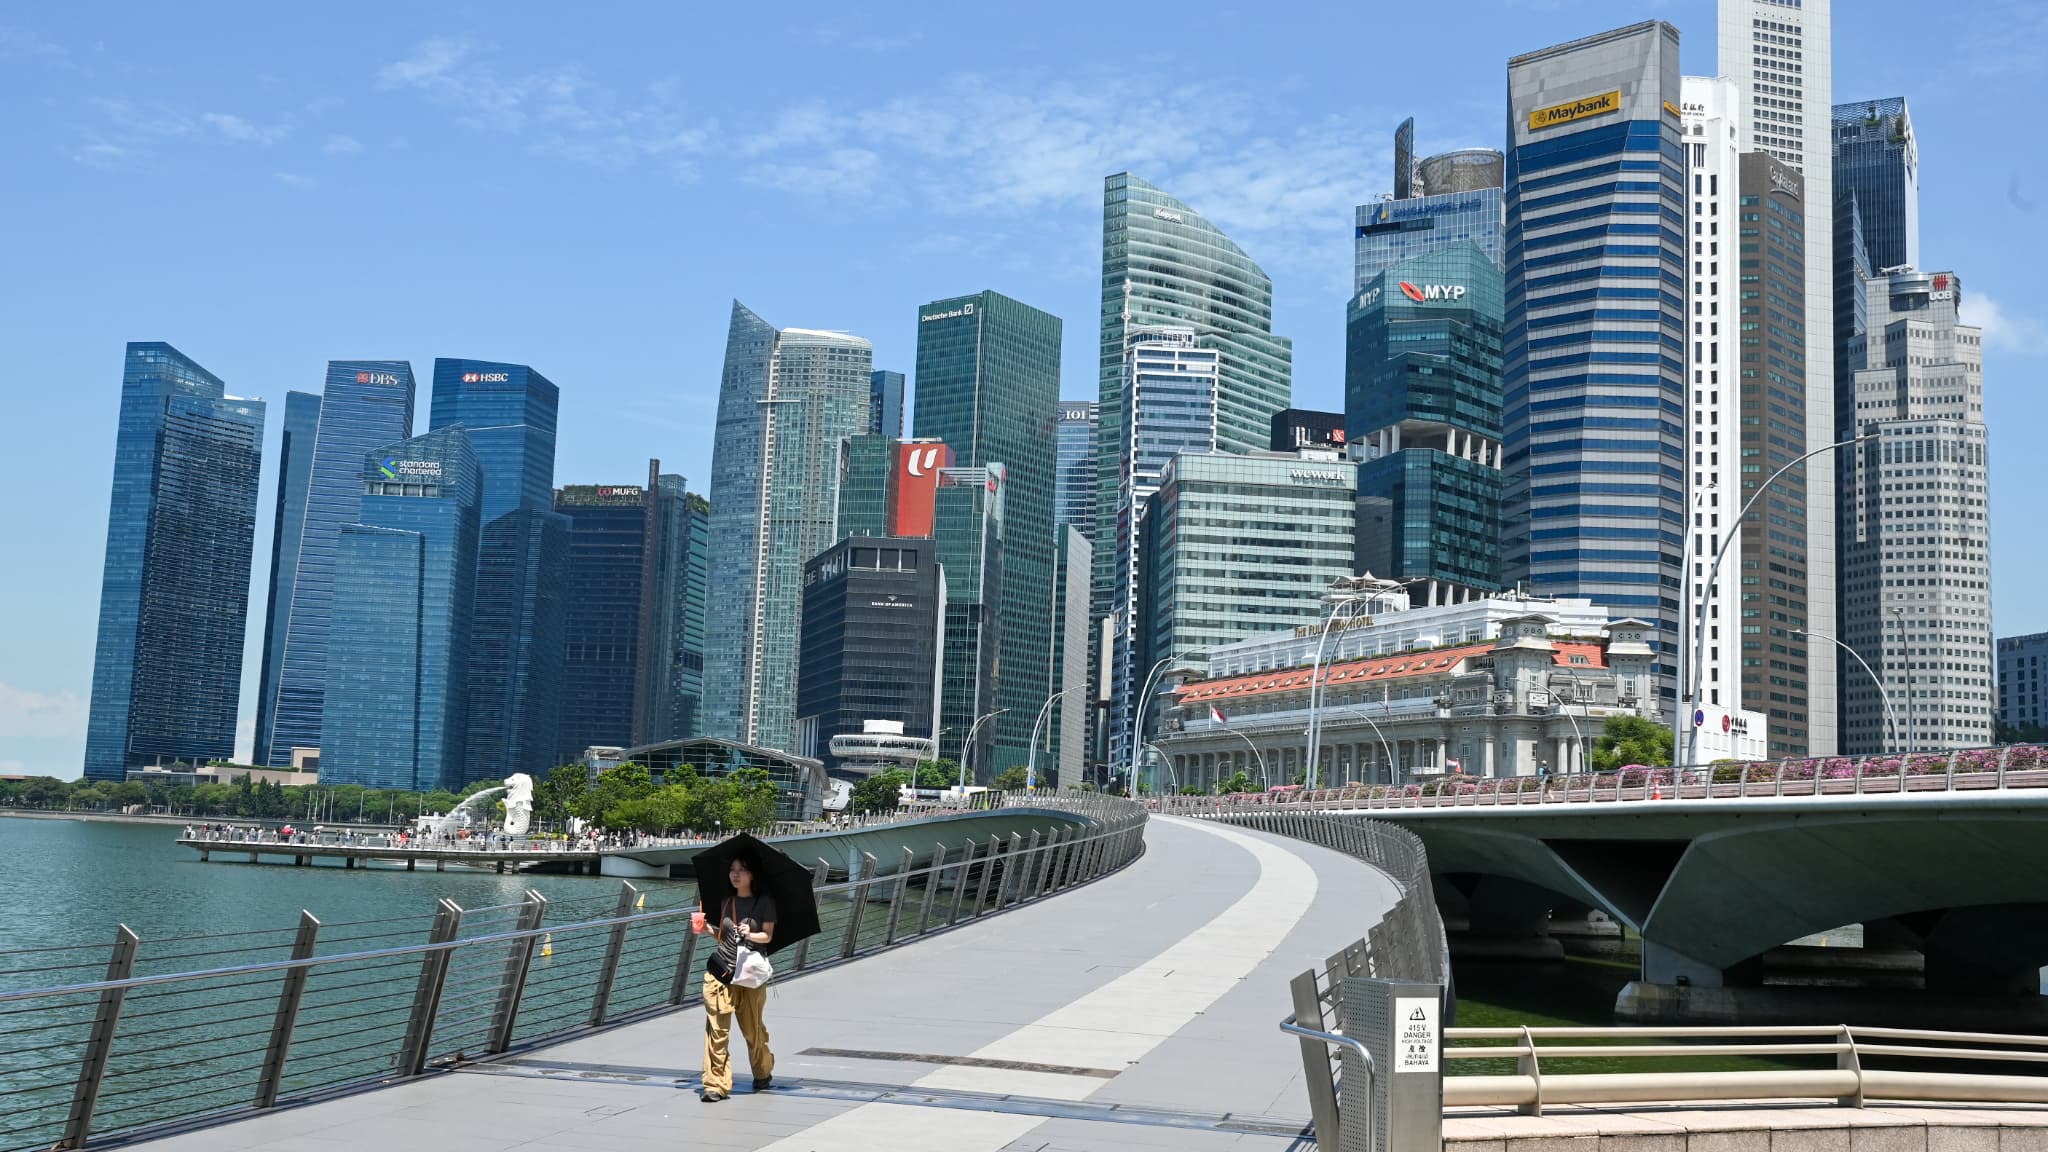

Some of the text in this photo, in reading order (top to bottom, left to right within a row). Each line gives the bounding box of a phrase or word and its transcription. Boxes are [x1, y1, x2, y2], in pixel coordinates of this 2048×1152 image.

[1548, 96, 1611, 121] Maybank
[1425, 284, 1465, 300] MYP
[1929, 290, 1953, 300] UOB
[1360, 287, 1380, 309] MYP
[949, 309, 963, 318] Bank
[370, 372, 398, 385] DBS
[480, 373, 509, 382] HSBC
[1066, 410, 1086, 420] IOI
[400, 459, 440, 469] standard
[399, 467, 442, 476] chartered
[1291, 467, 1345, 480] wework
[612, 487, 639, 496] MUFG
[1295, 626, 1307, 638] THE
[1350, 616, 1374, 629] HOTEL
[1403, 1031, 1431, 1039] DANGER
